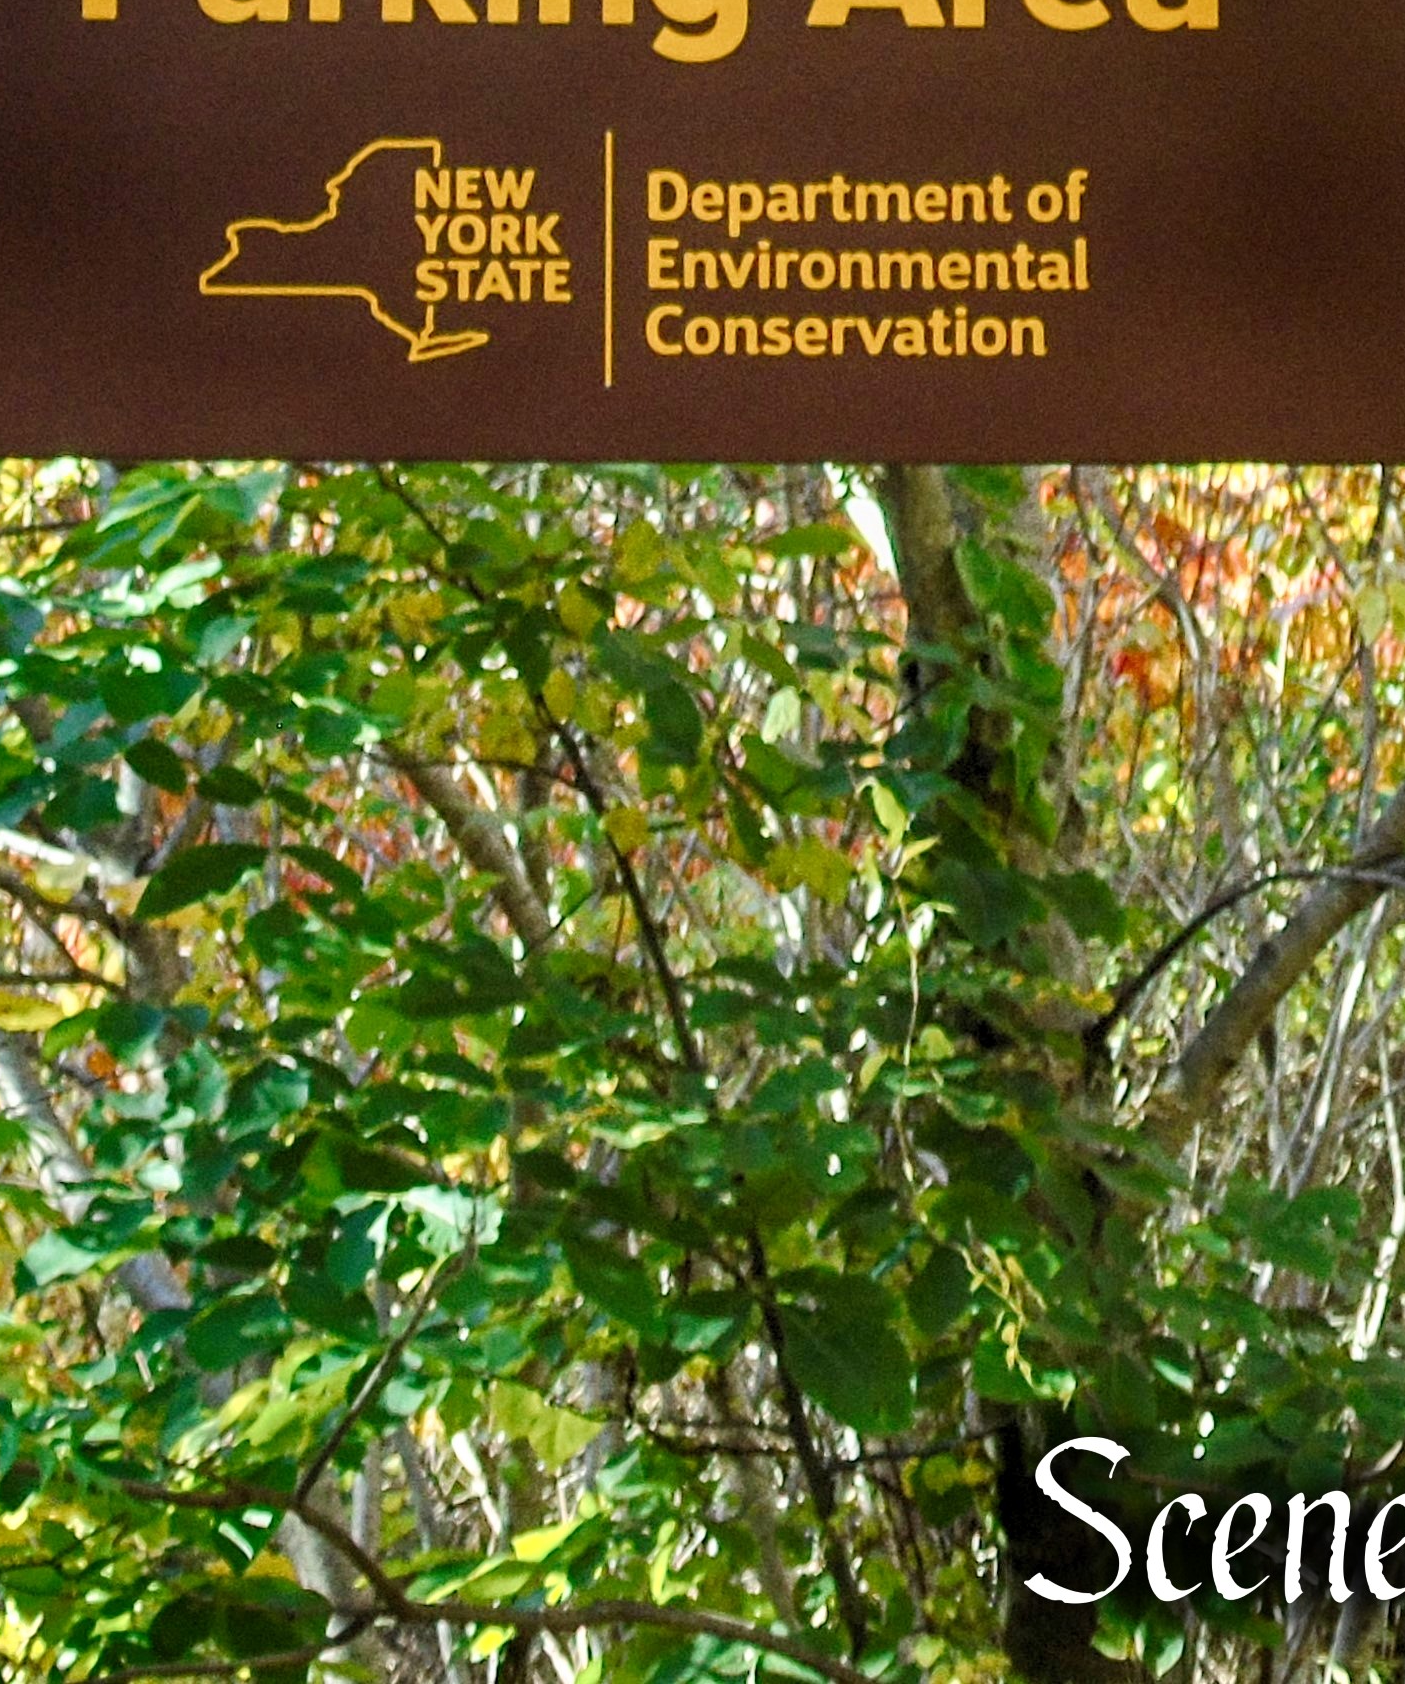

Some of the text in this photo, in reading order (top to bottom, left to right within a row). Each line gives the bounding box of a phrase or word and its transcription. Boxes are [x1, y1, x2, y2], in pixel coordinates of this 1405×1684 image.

[414, 168, 535, 209] NEW
[645, 168, 1089, 236] Department of
[414, 214, 561, 256] YORK
[414, 260, 572, 304] STATE
[646, 237, 1090, 292] Environmental
[644, 302, 1048, 357] Conservation
